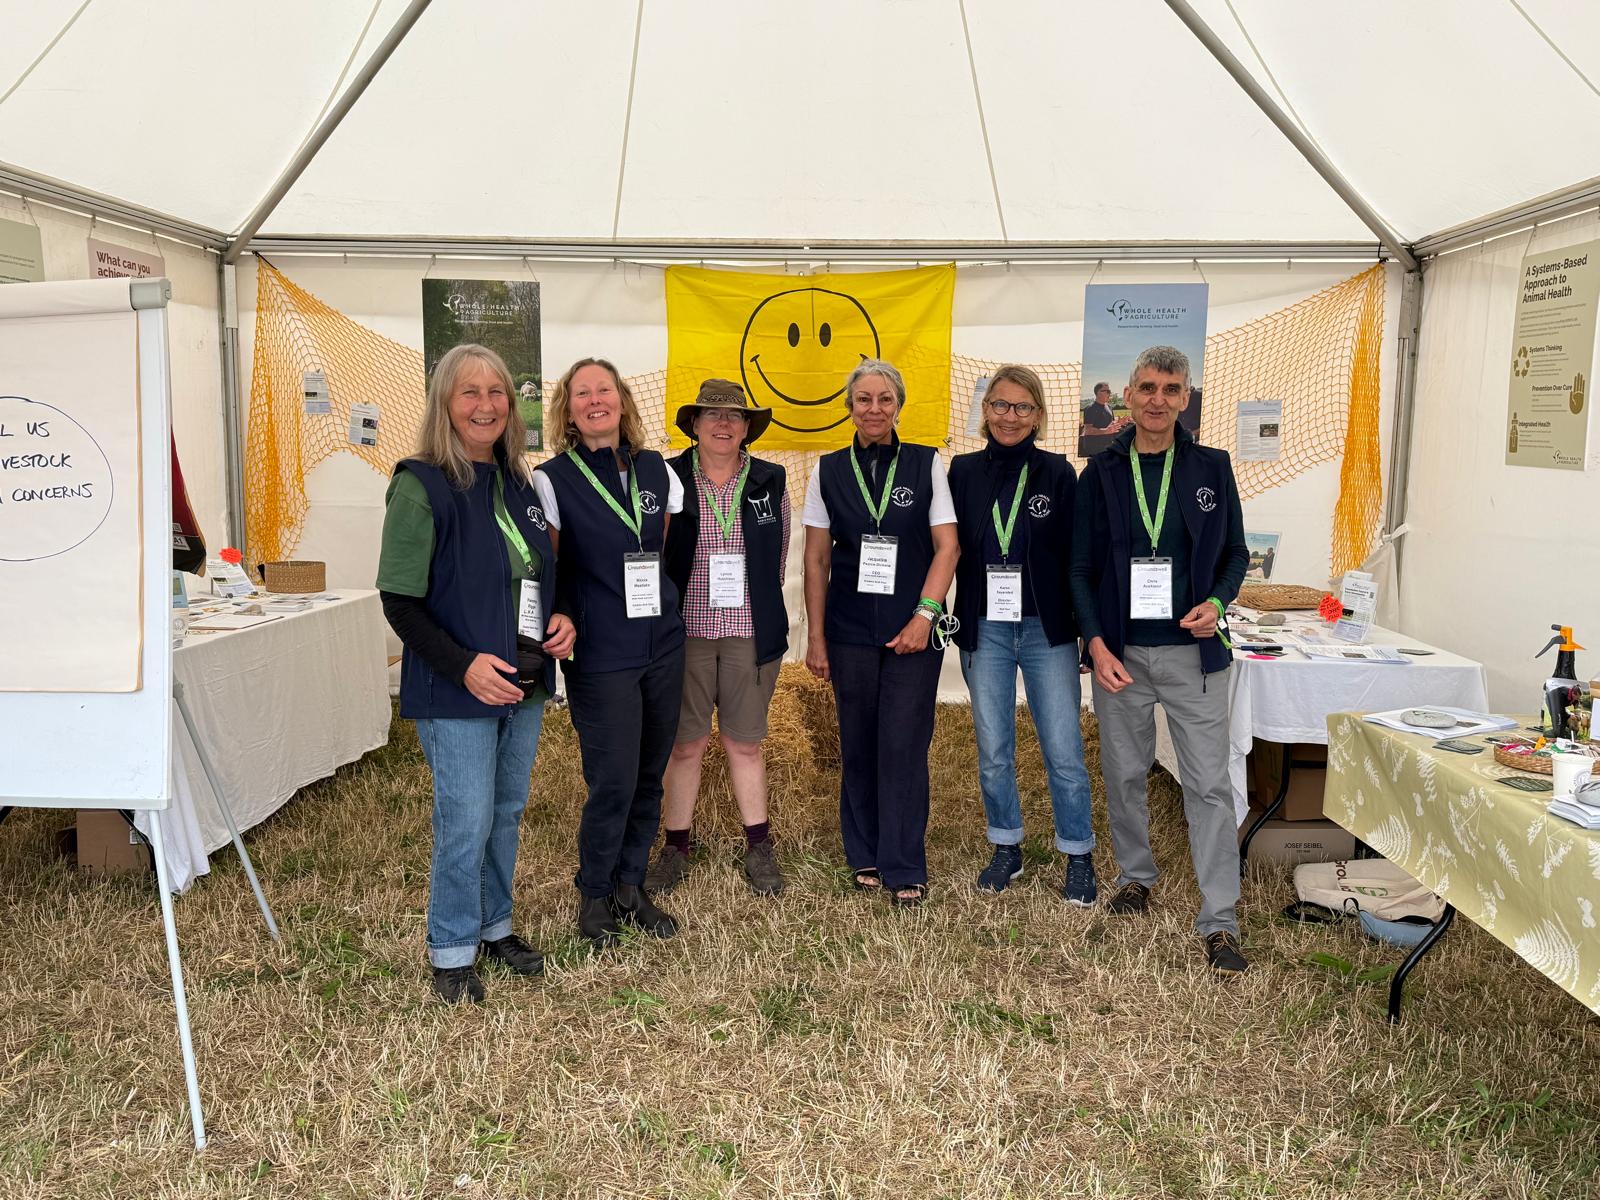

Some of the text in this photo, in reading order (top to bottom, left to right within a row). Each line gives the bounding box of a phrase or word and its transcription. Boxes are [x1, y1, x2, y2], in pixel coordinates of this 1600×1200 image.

[96, 250, 151, 275] What can you
[1525, 254, 1588, 278] A Systems-Based
[1523, 273, 1567, 292] Approach to
[1522, 285, 1573, 304] Animal Health
[1529, 344, 1563, 353] Systems Thinking
[26, 421, 50, 438] US
[1, 452, 73, 470] VESTOCK
[11, 483, 94, 502] CONCERNS
